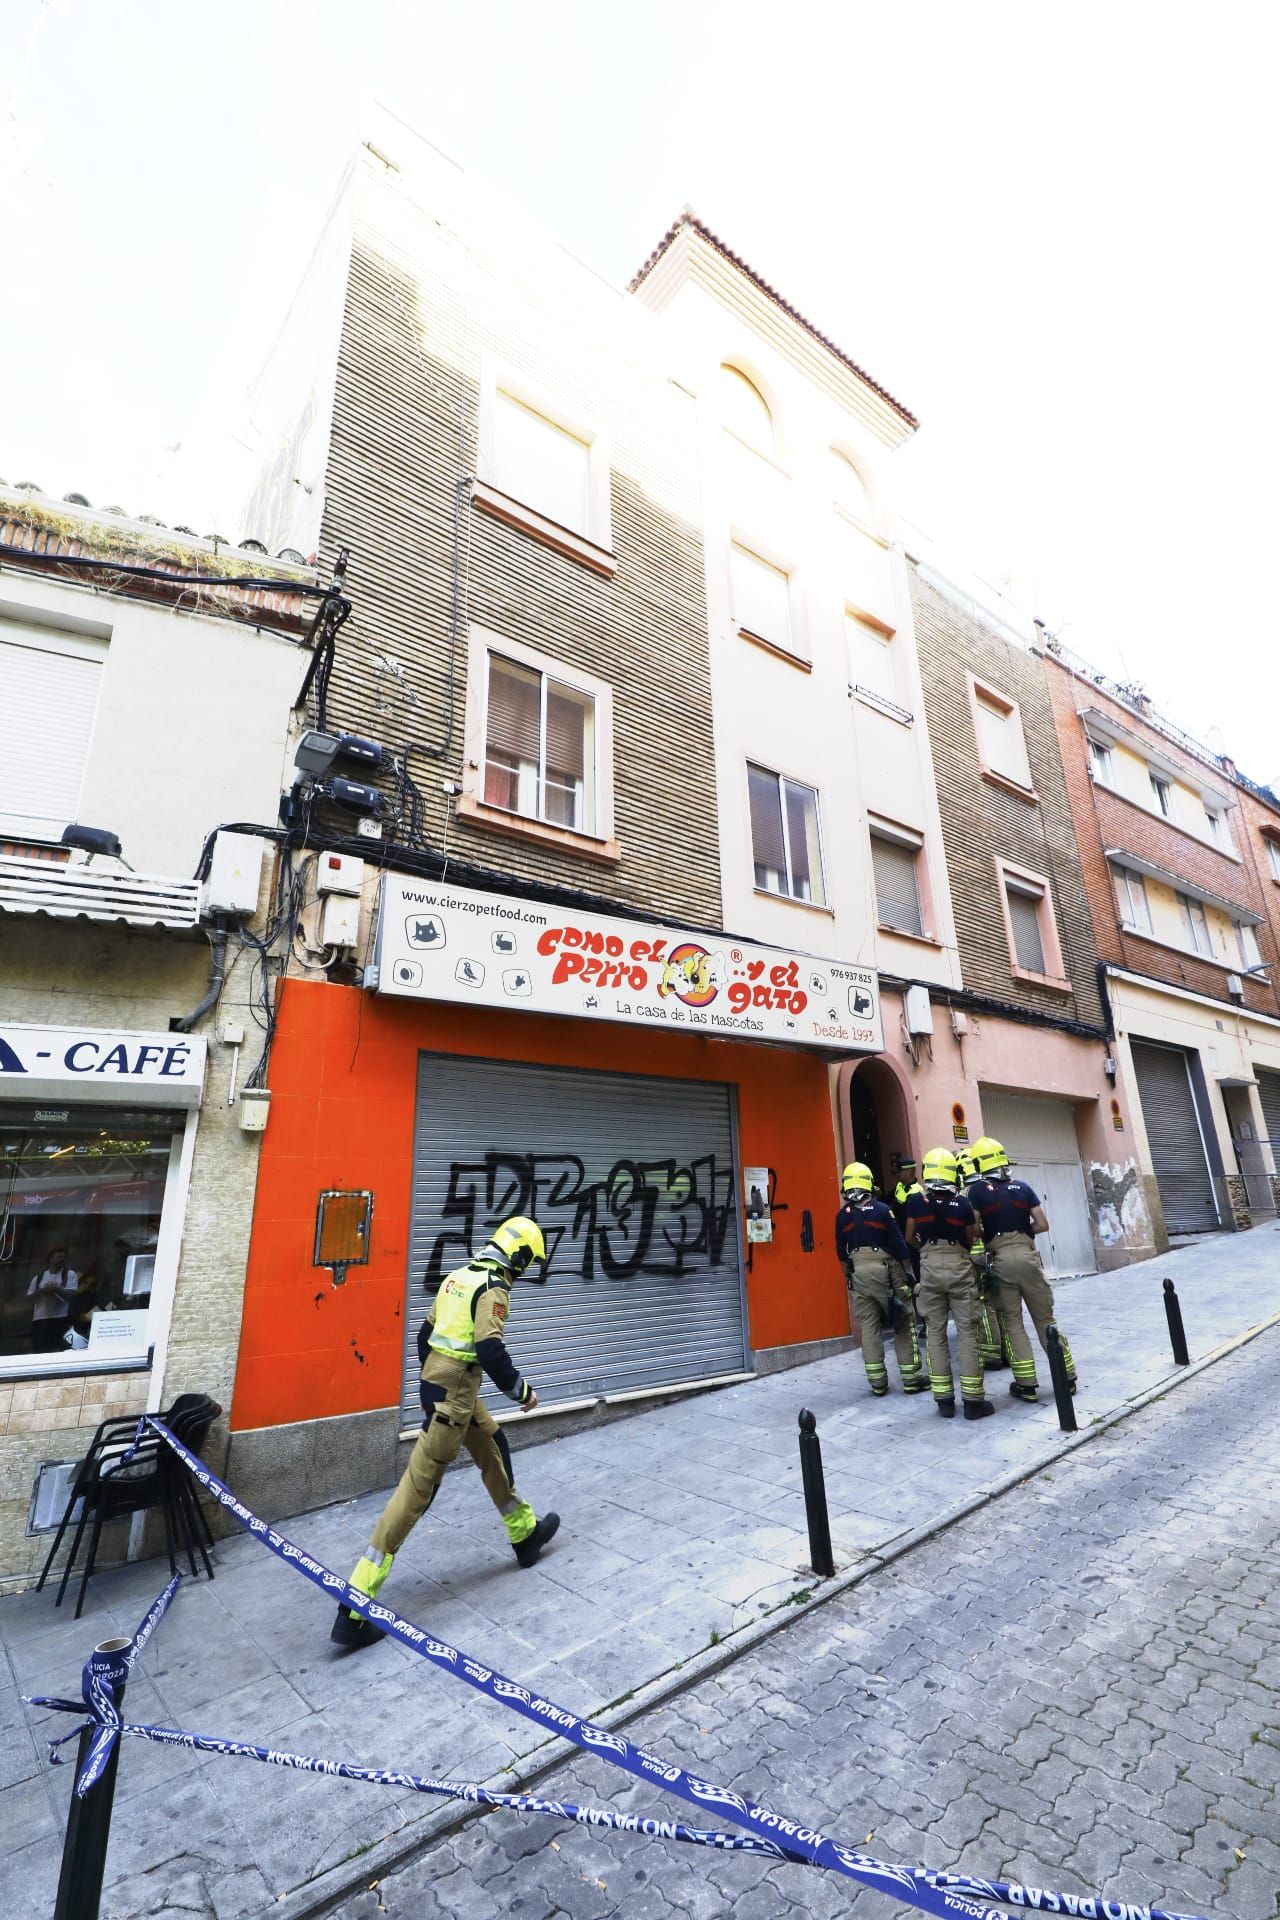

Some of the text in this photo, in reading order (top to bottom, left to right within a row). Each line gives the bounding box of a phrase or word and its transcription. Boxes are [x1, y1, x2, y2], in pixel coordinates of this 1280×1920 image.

[402, 890, 547, 925] www.cierzopetfood.com
[552, 952, 648, 991] Perro
[616, 1000, 631, 1014] La
[636, 1004, 667, 1019] casa
[671, 1007, 685, 1021] de
[689, 1009, 708, 1024] las
[812, 1021, 874, 1042] Desde 1993
[64, 1042, 191, 1076] CAFÉ
[530, 1698, 581, 1729] NO PASAR
[266, 1750, 315, 1771] PASAR
[576, 1806, 677, 1840] NO PASAR
[750, 1806, 828, 1848] NO PASAR
[944, 1895, 985, 1919] POLICIA
[1008, 1884, 1098, 1919] PASAR
